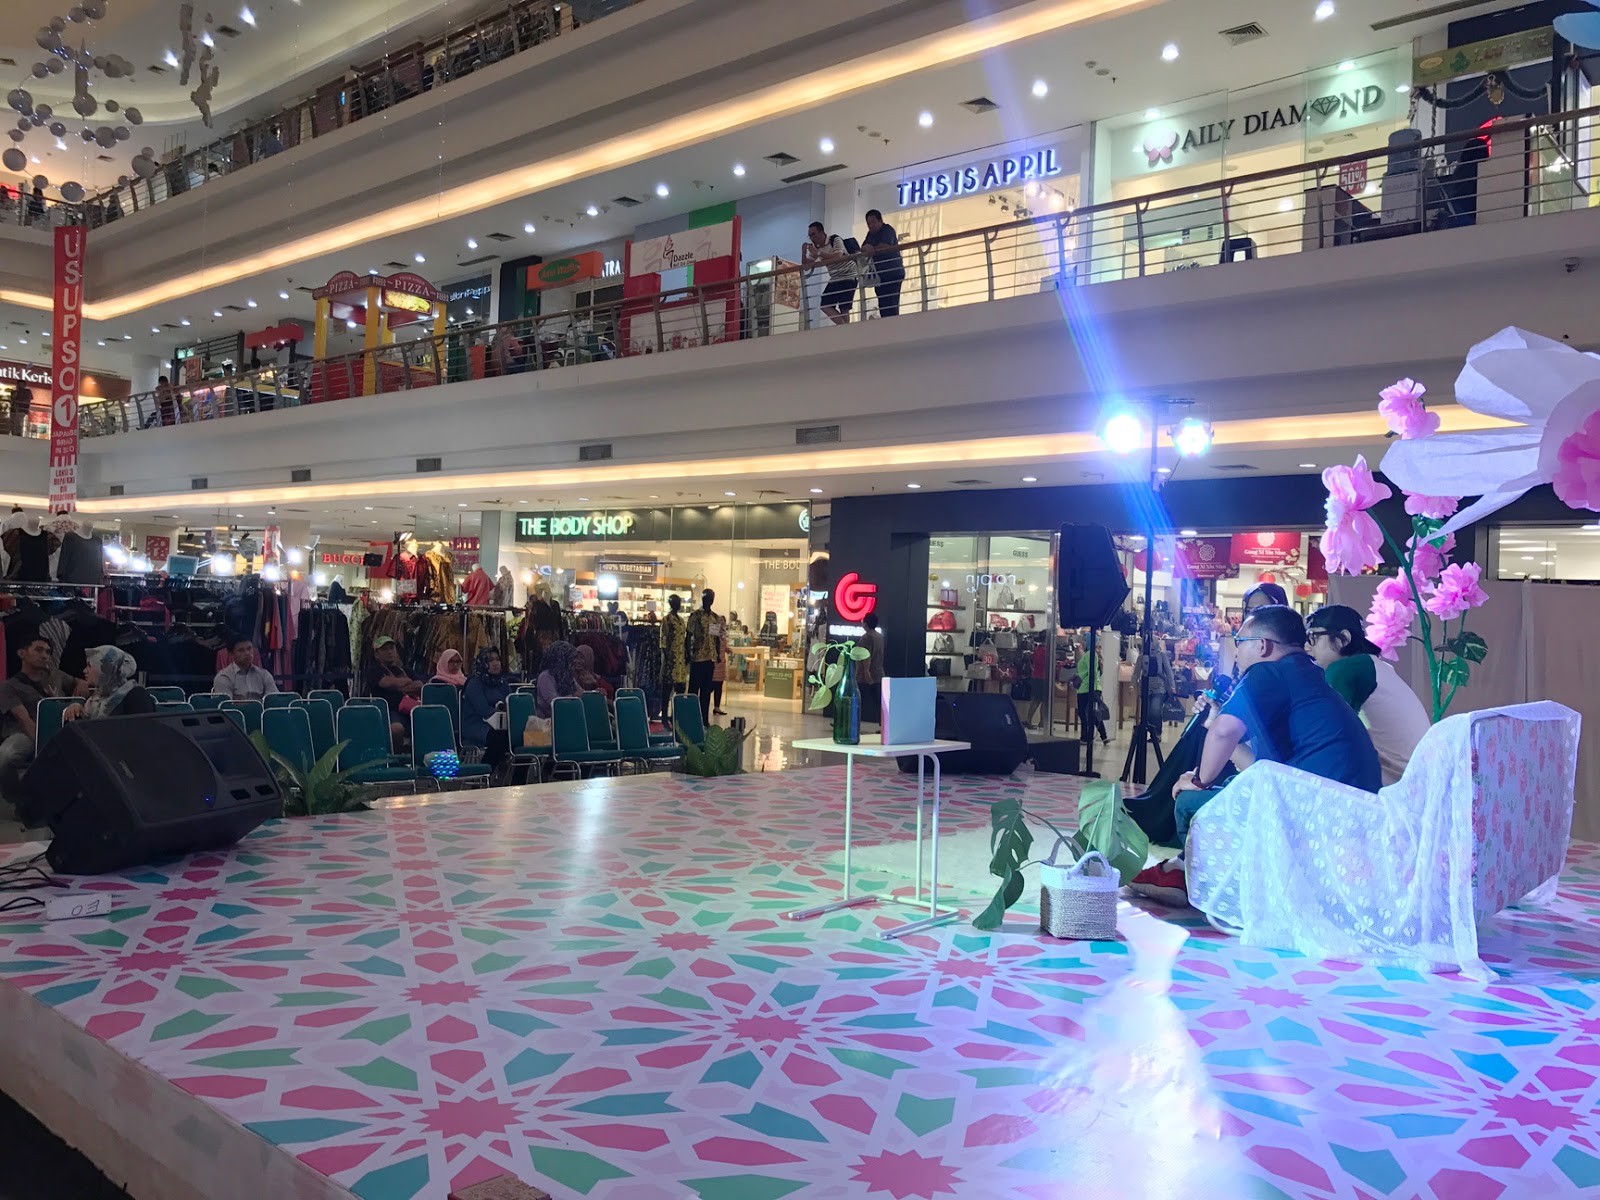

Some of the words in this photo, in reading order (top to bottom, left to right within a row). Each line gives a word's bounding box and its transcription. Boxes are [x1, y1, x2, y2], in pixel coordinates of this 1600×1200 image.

[1182, 119, 1235, 150] AILY
[954, 167, 978, 193] IS
[982, 150, 1061, 188] APRIL
[674, 252, 693, 262] Dazzle
[329, 280, 354, 294] PIZZA
[394, 280, 430, 296] PIZZA
[0, 367, 20, 380] tik
[22, 368, 53, 384] Keris
[519, 517, 547, 536] THE
[550, 516, 592, 536] BODY
[592, 516, 633, 536] SHOP
[1012, 550, 1029, 558] GUESS
[619, 564, 652, 574] VEGETARIAN
[764, 560, 780, 569] THE
